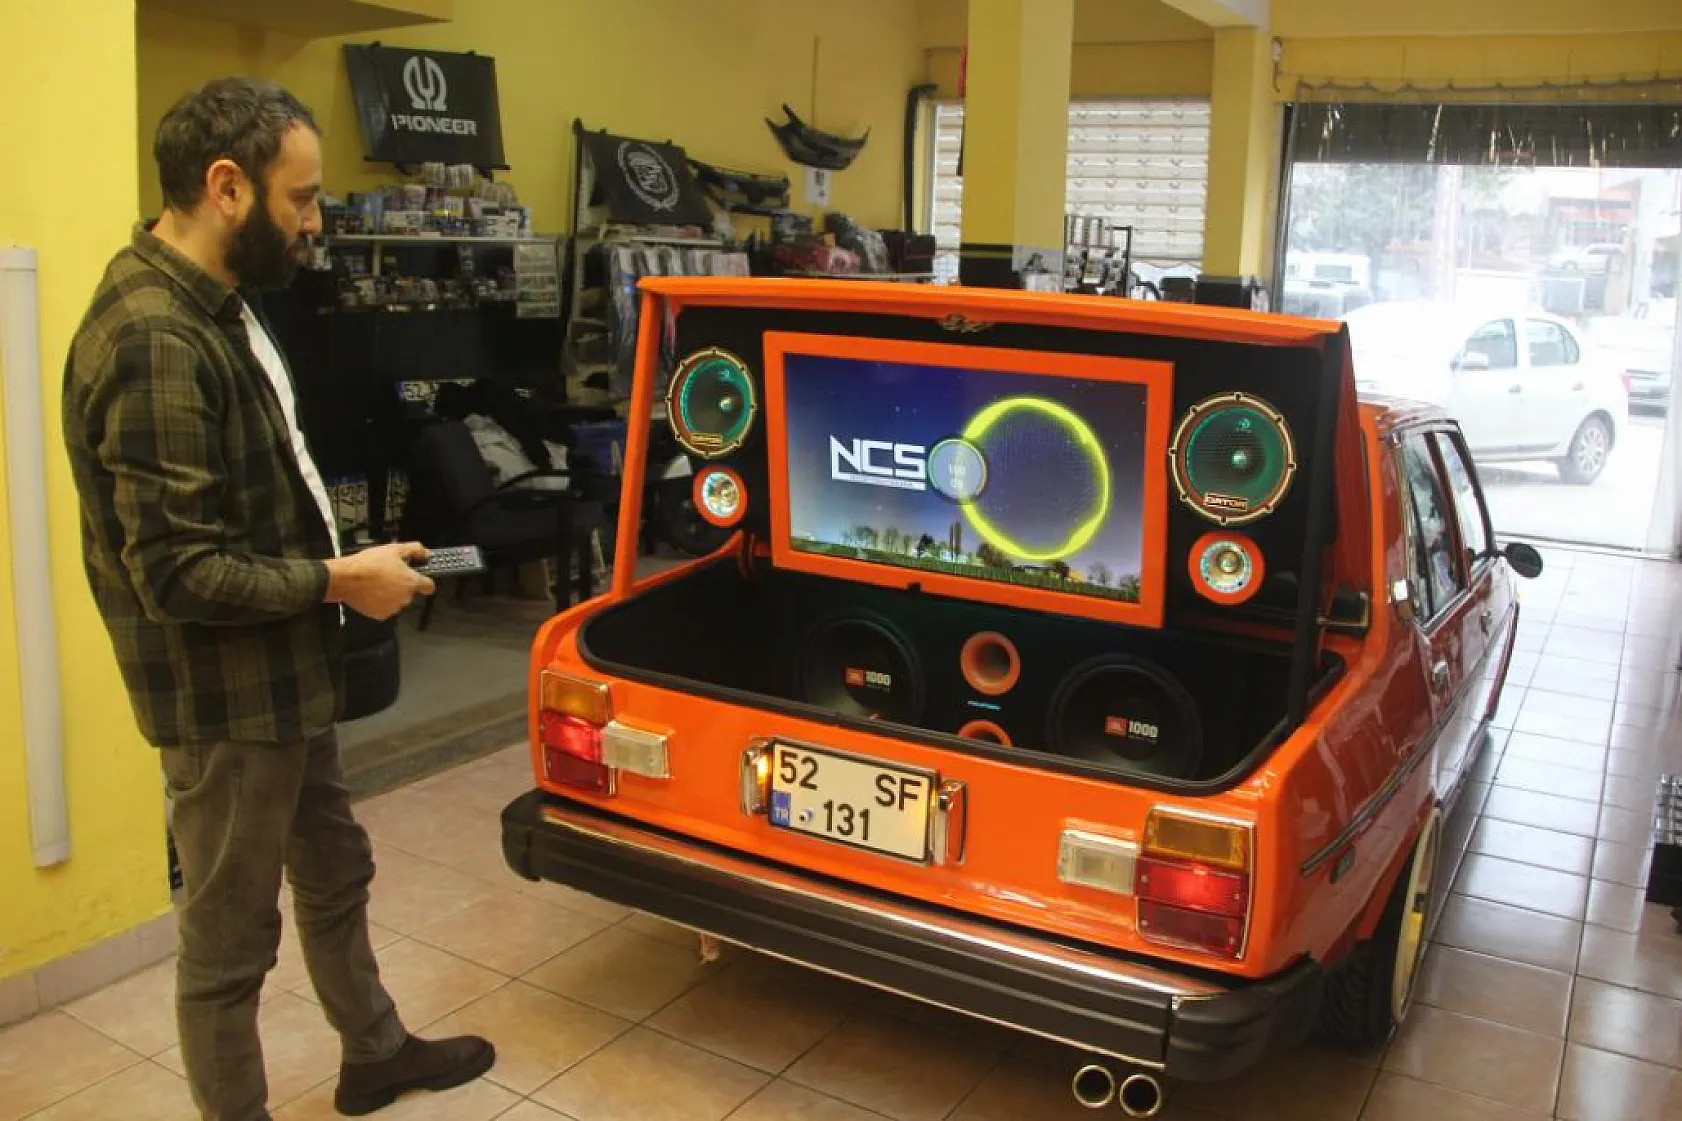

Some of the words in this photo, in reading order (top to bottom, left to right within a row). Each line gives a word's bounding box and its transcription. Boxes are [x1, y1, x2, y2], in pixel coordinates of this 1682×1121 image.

[391, 114, 477, 135] PIONEER
[830, 435, 926, 490] NCS
[1128, 720, 1158, 737] 1000
[780, 751, 819, 790] 52
[875, 774, 922, 811] SF
[823, 800, 870, 841] 131
